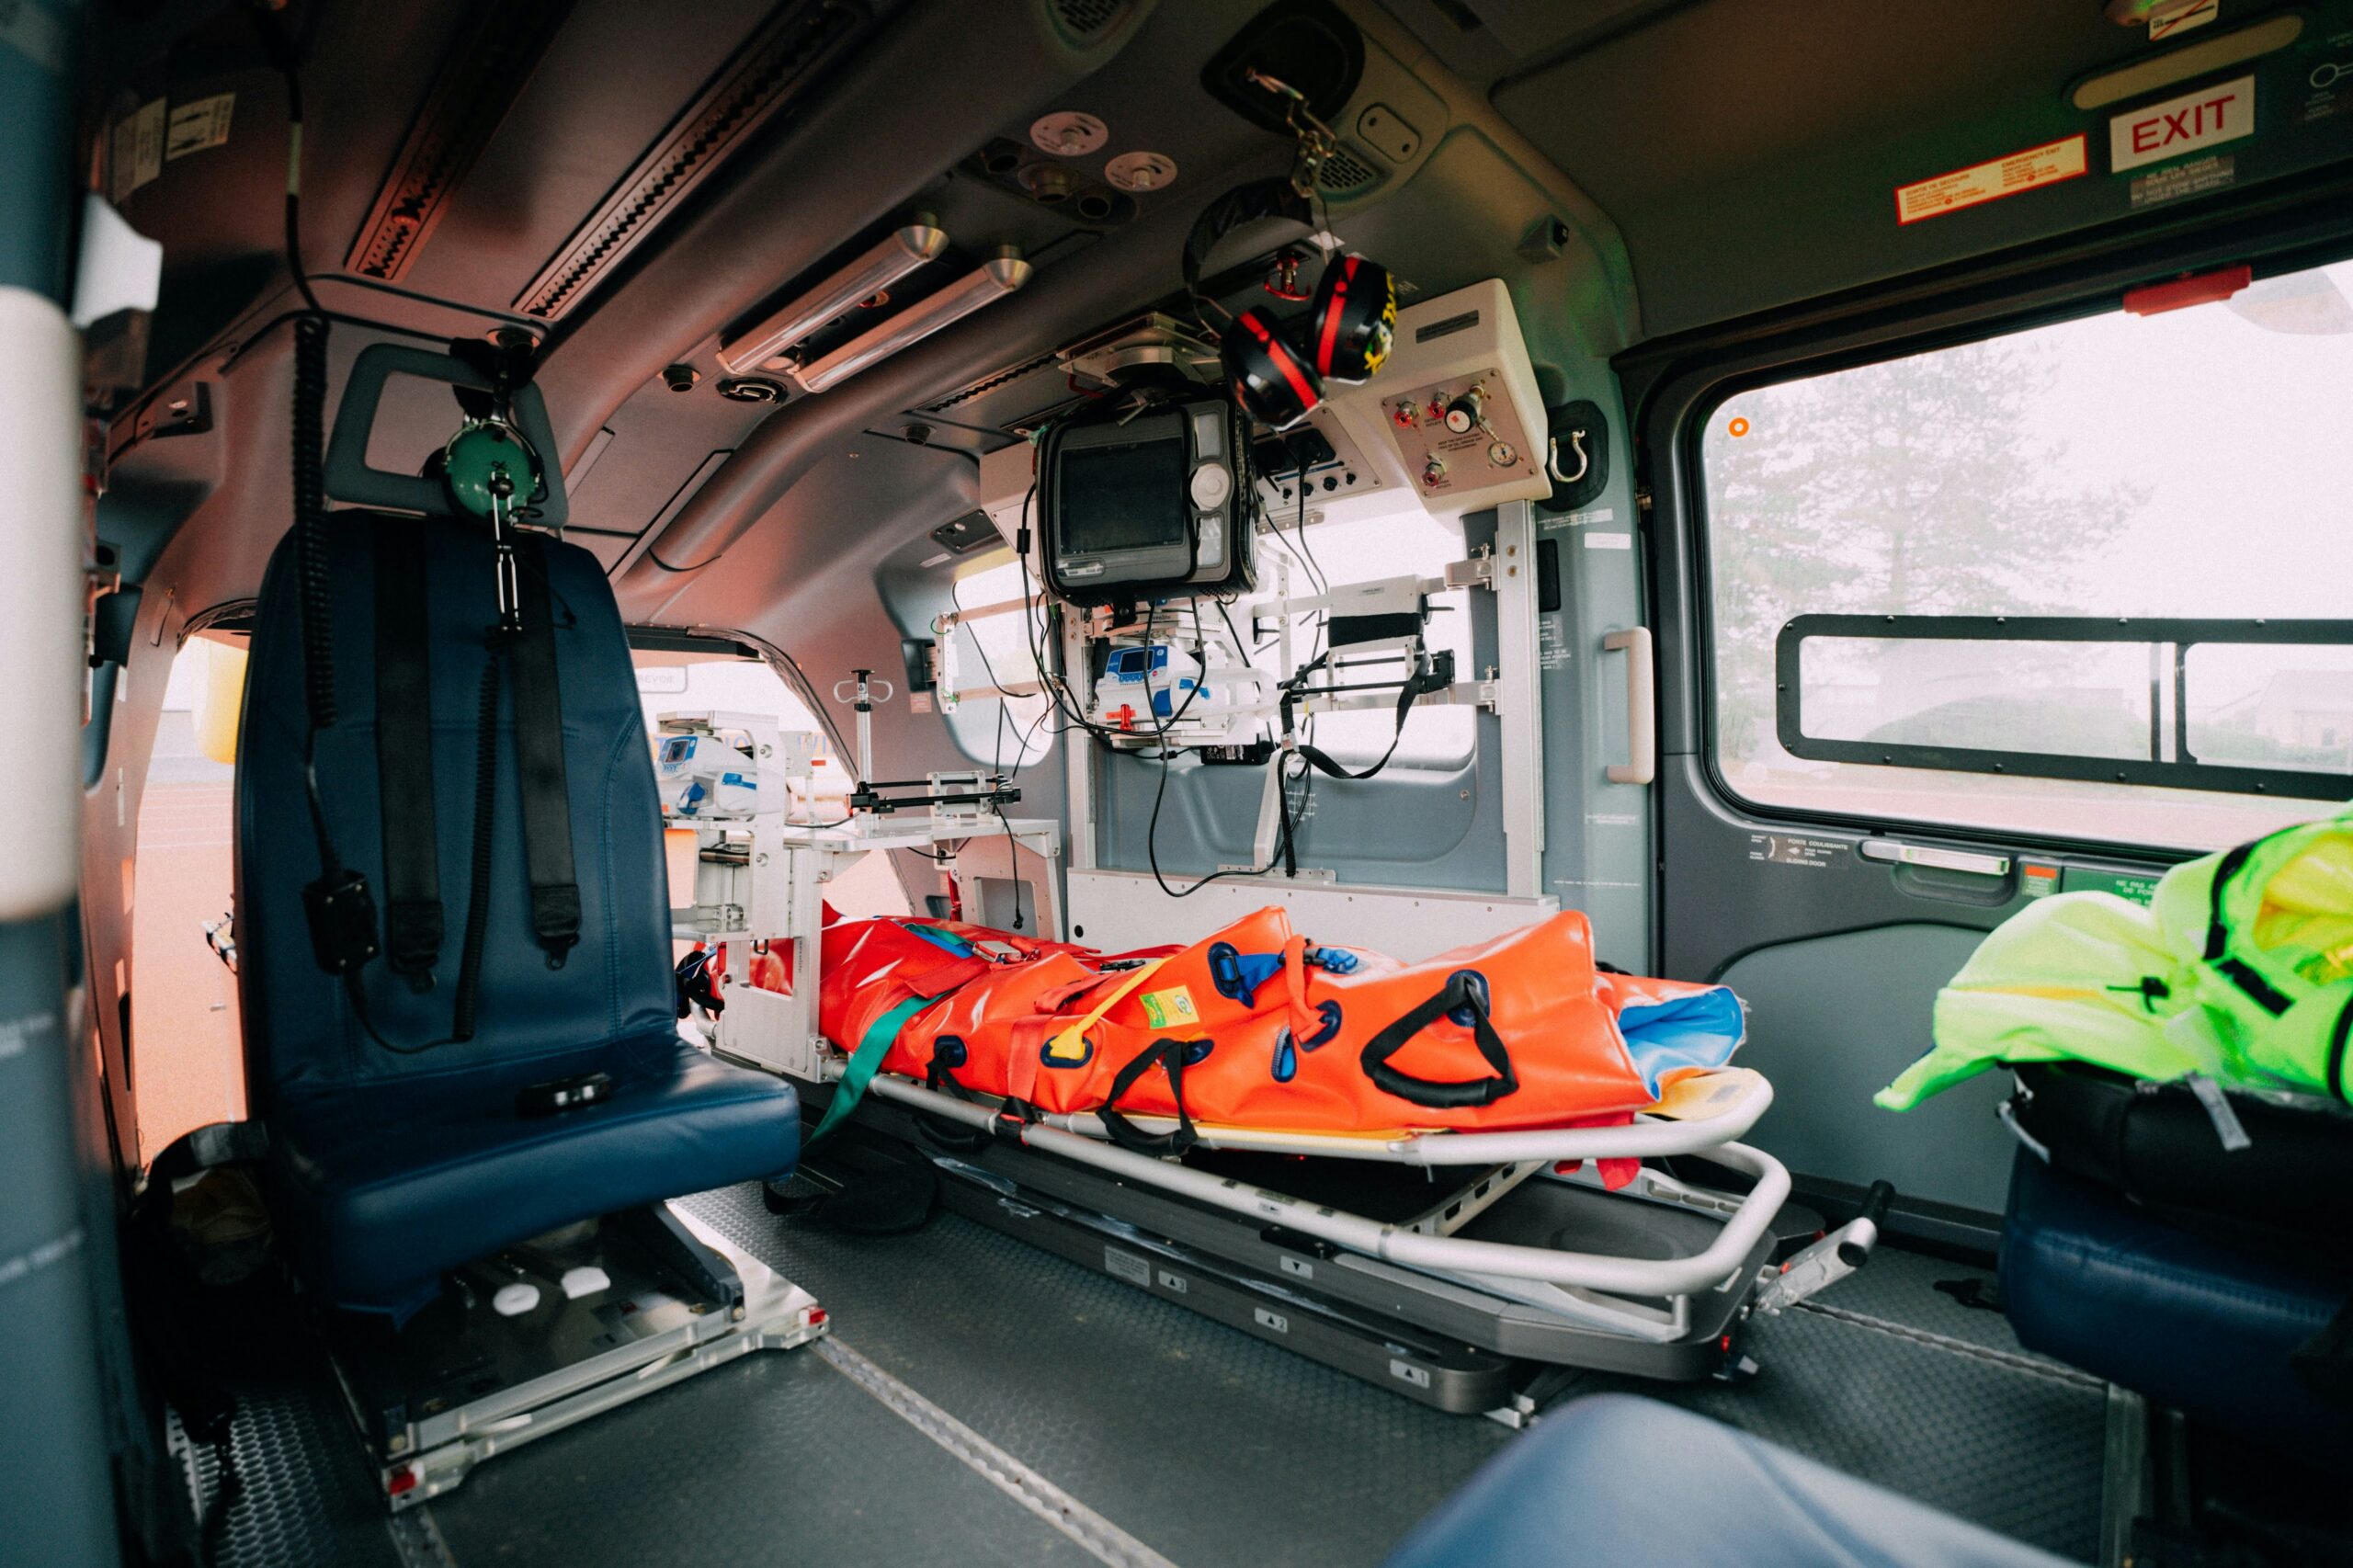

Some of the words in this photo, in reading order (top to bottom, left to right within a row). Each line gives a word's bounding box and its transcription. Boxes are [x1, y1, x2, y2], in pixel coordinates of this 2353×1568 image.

[2132, 94, 2236, 154] EXIT
[1809, 841, 1848, 850] COULISSANTE
[1279, 1318, 1285, 1330] 2
